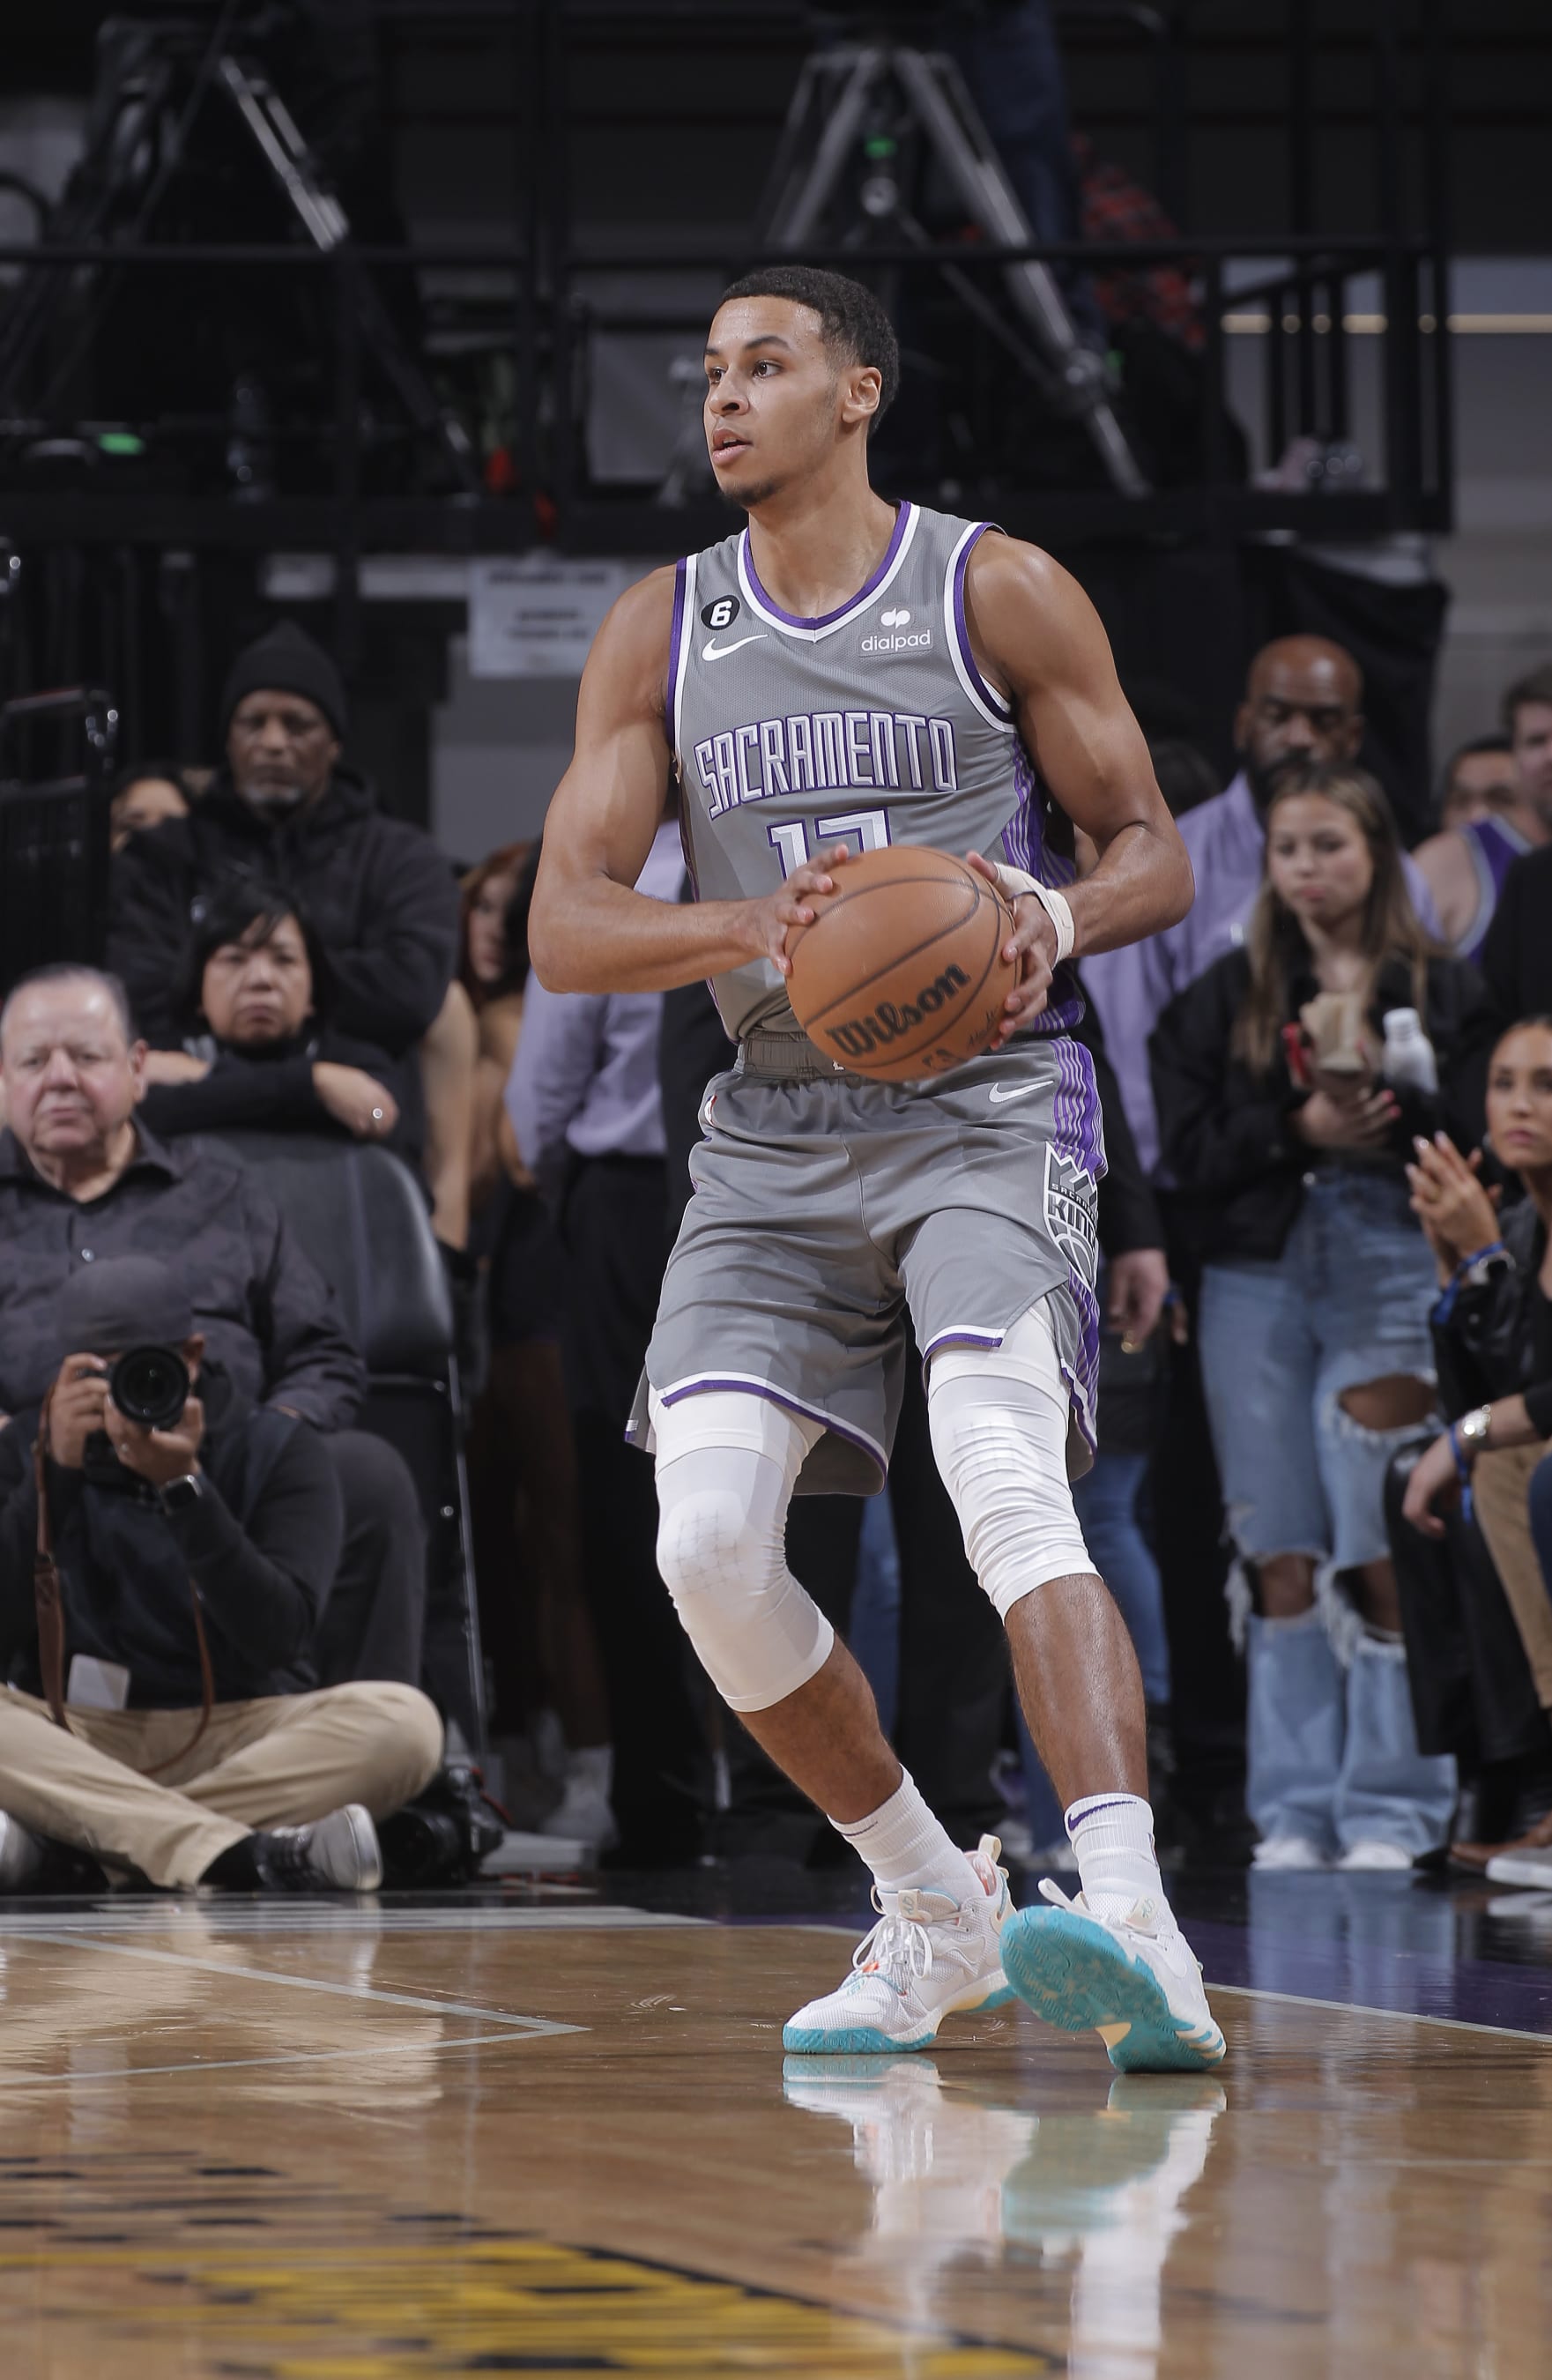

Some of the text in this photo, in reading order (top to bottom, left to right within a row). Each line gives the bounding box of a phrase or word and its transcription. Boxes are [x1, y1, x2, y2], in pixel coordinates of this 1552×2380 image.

[710, 600, 732, 626] 6
[861, 630, 931, 653] dialpad
[694, 711, 958, 821] SACRAMENTO
[826, 964, 970, 1056] Wilson
